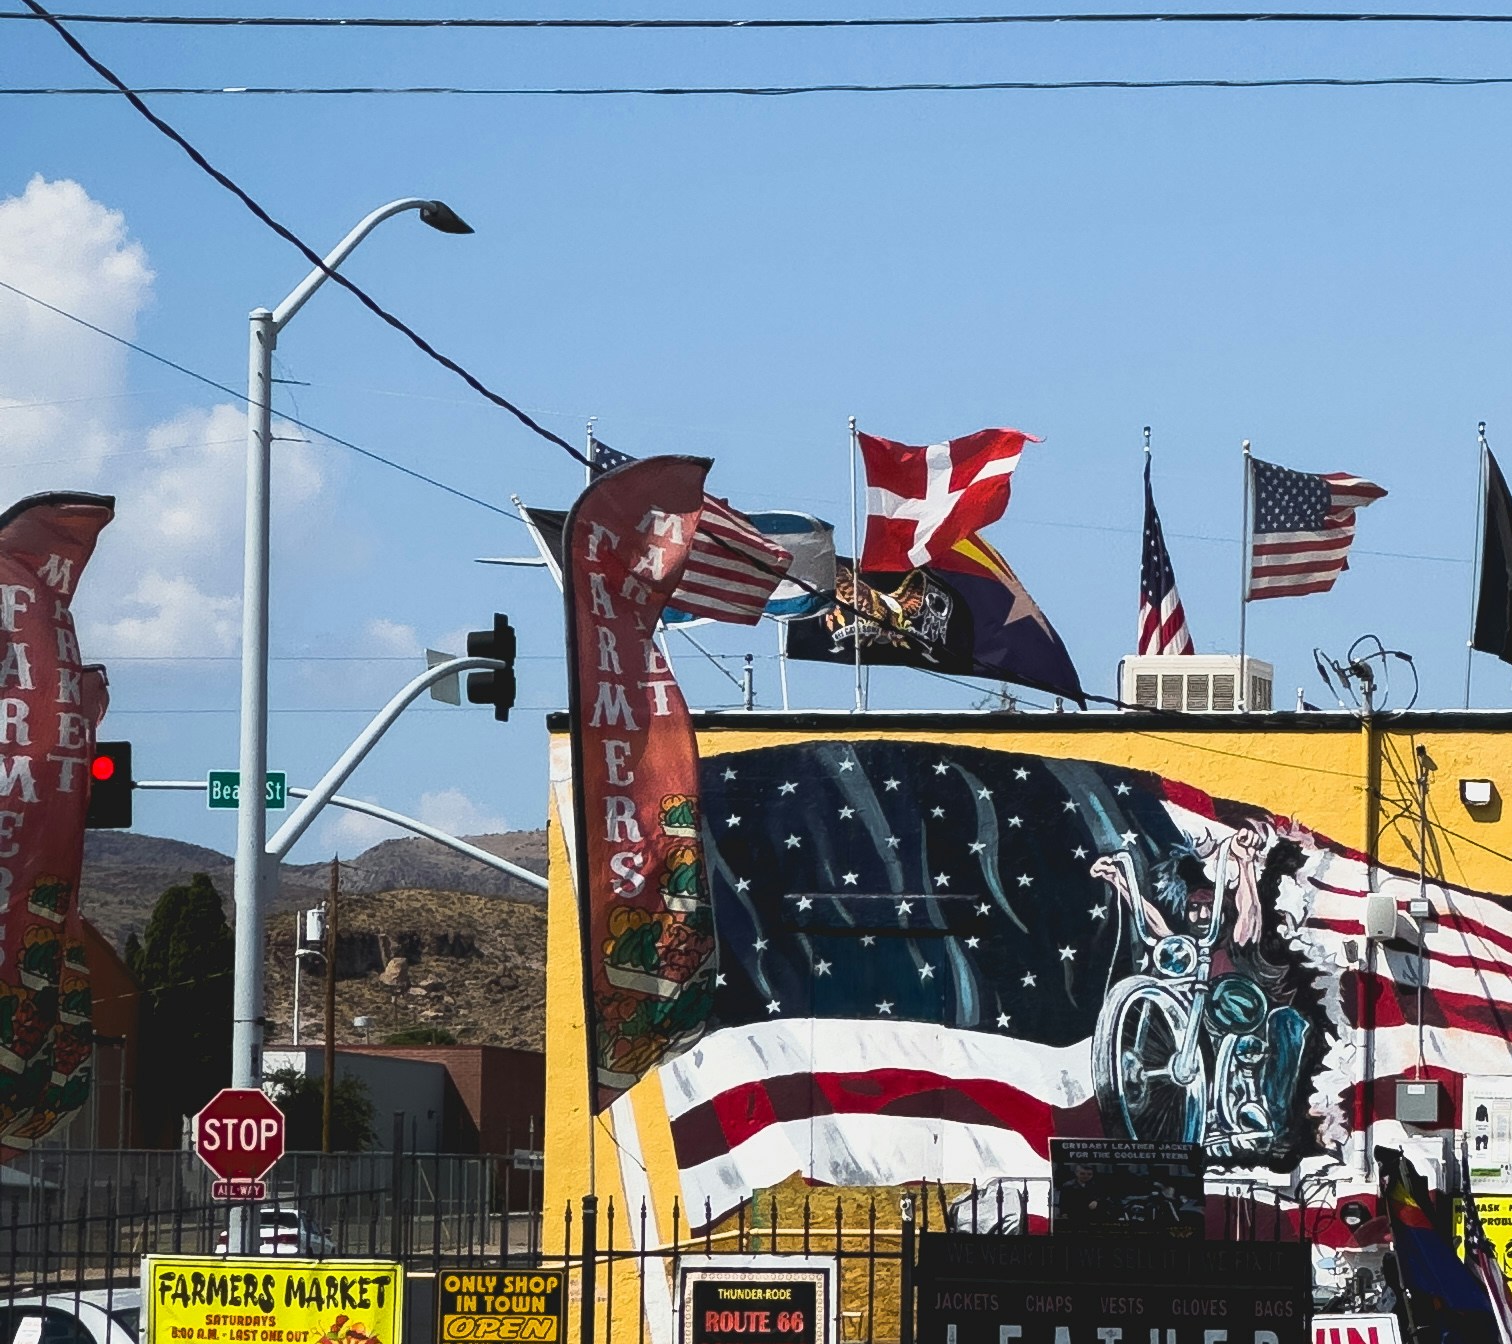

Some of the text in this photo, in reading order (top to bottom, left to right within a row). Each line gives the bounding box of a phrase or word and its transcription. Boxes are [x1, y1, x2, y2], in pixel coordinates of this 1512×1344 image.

[266, 781, 281, 800] St
[203, 1118, 278, 1151] STOP
[1159, 1143, 1193, 1151] JACKET
[159, 1271, 392, 1313] FARMERS MARKET
[444, 1275, 558, 1294] ONLY SHOP
[718, 1288, 792, 1300] THUNDER-RODE
[456, 1295, 546, 1313] IN TOWN
[934, 1293, 1295, 1318] JACKETS CHAPS VESTS GLOVES BAGS
[206, 1315, 276, 1327] SATURDAYS
[447, 1316, 555, 1340] OPEN
[705, 1311, 804, 1333] ROUTE 66
[230, 1329, 258, 1341] LAST
[286, 1331, 309, 1342] OUT
